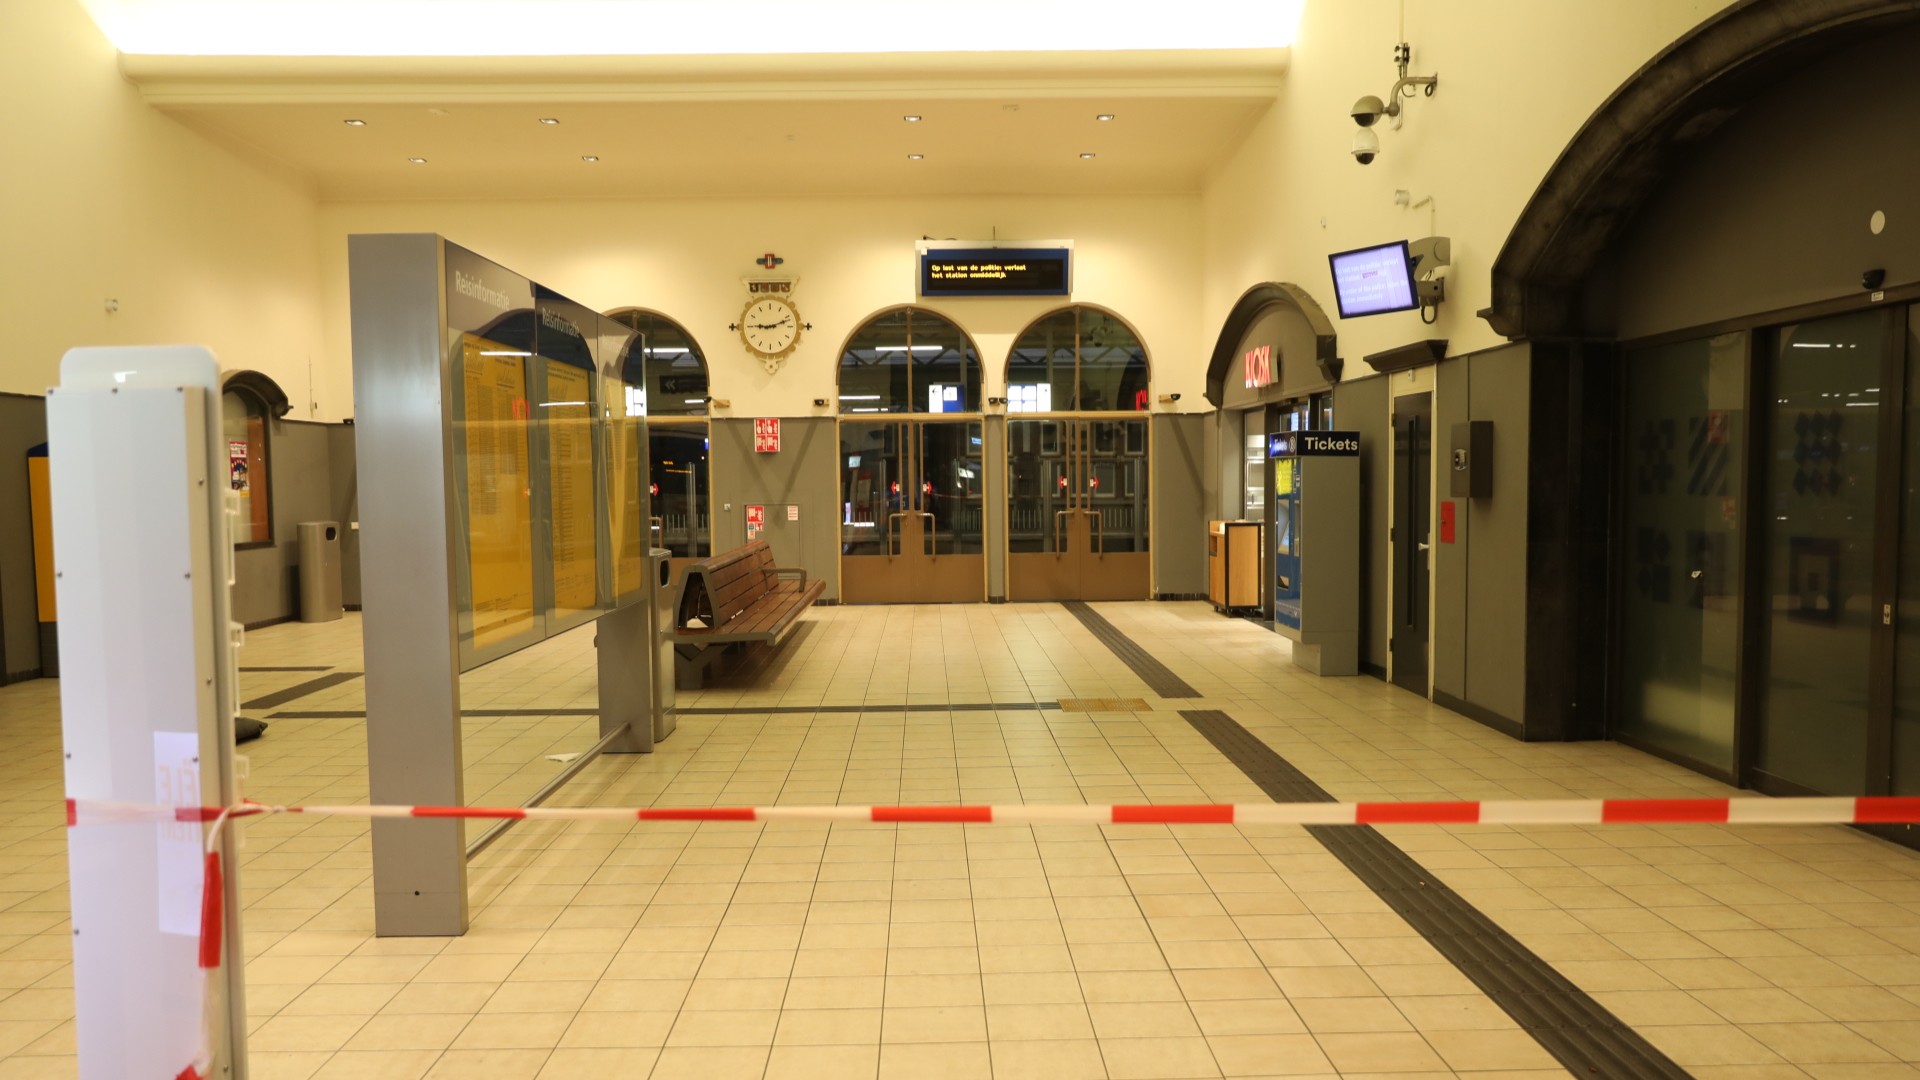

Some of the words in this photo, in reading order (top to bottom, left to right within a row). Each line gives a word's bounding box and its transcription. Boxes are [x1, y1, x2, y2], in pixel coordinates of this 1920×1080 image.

[931, 264, 941, 272] Op
[942, 264, 955, 272] last
[957, 264, 969, 272] van
[970, 264, 979, 272] de
[1004, 264, 1026, 272] verlaat
[931, 271, 943, 279] het
[945, 271, 968, 279] station
[455, 270, 510, 311] Reisinformatie
[542, 306, 580, 339] Reisinformatie
[1245, 345, 1271, 389] KIOSK
[1304, 437, 1358, 451] Tickets
